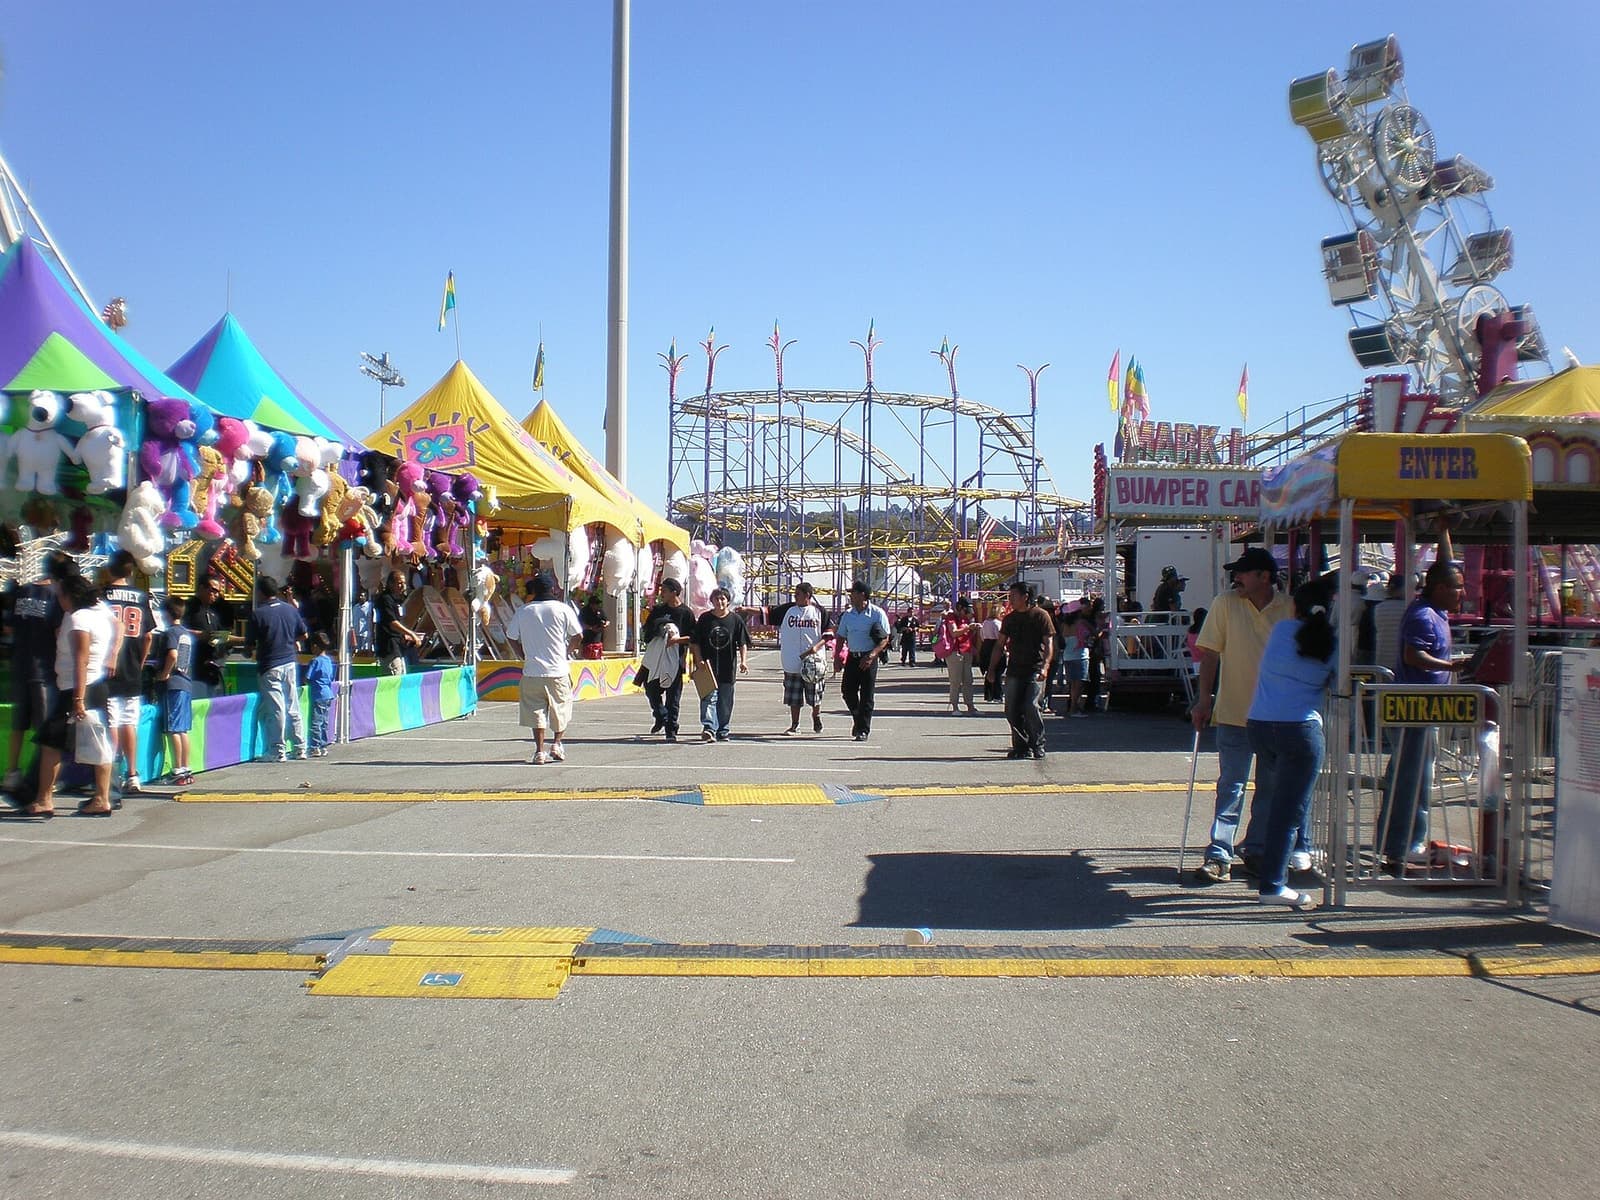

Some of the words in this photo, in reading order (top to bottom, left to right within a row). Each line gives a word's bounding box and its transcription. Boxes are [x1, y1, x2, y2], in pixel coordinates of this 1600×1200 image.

[1123, 420, 1221, 465] MARK
[1399, 447, 1479, 479] ENTER
[1115, 476, 1209, 507] BUMPER
[1385, 695, 1475, 721] ENTRANCE
